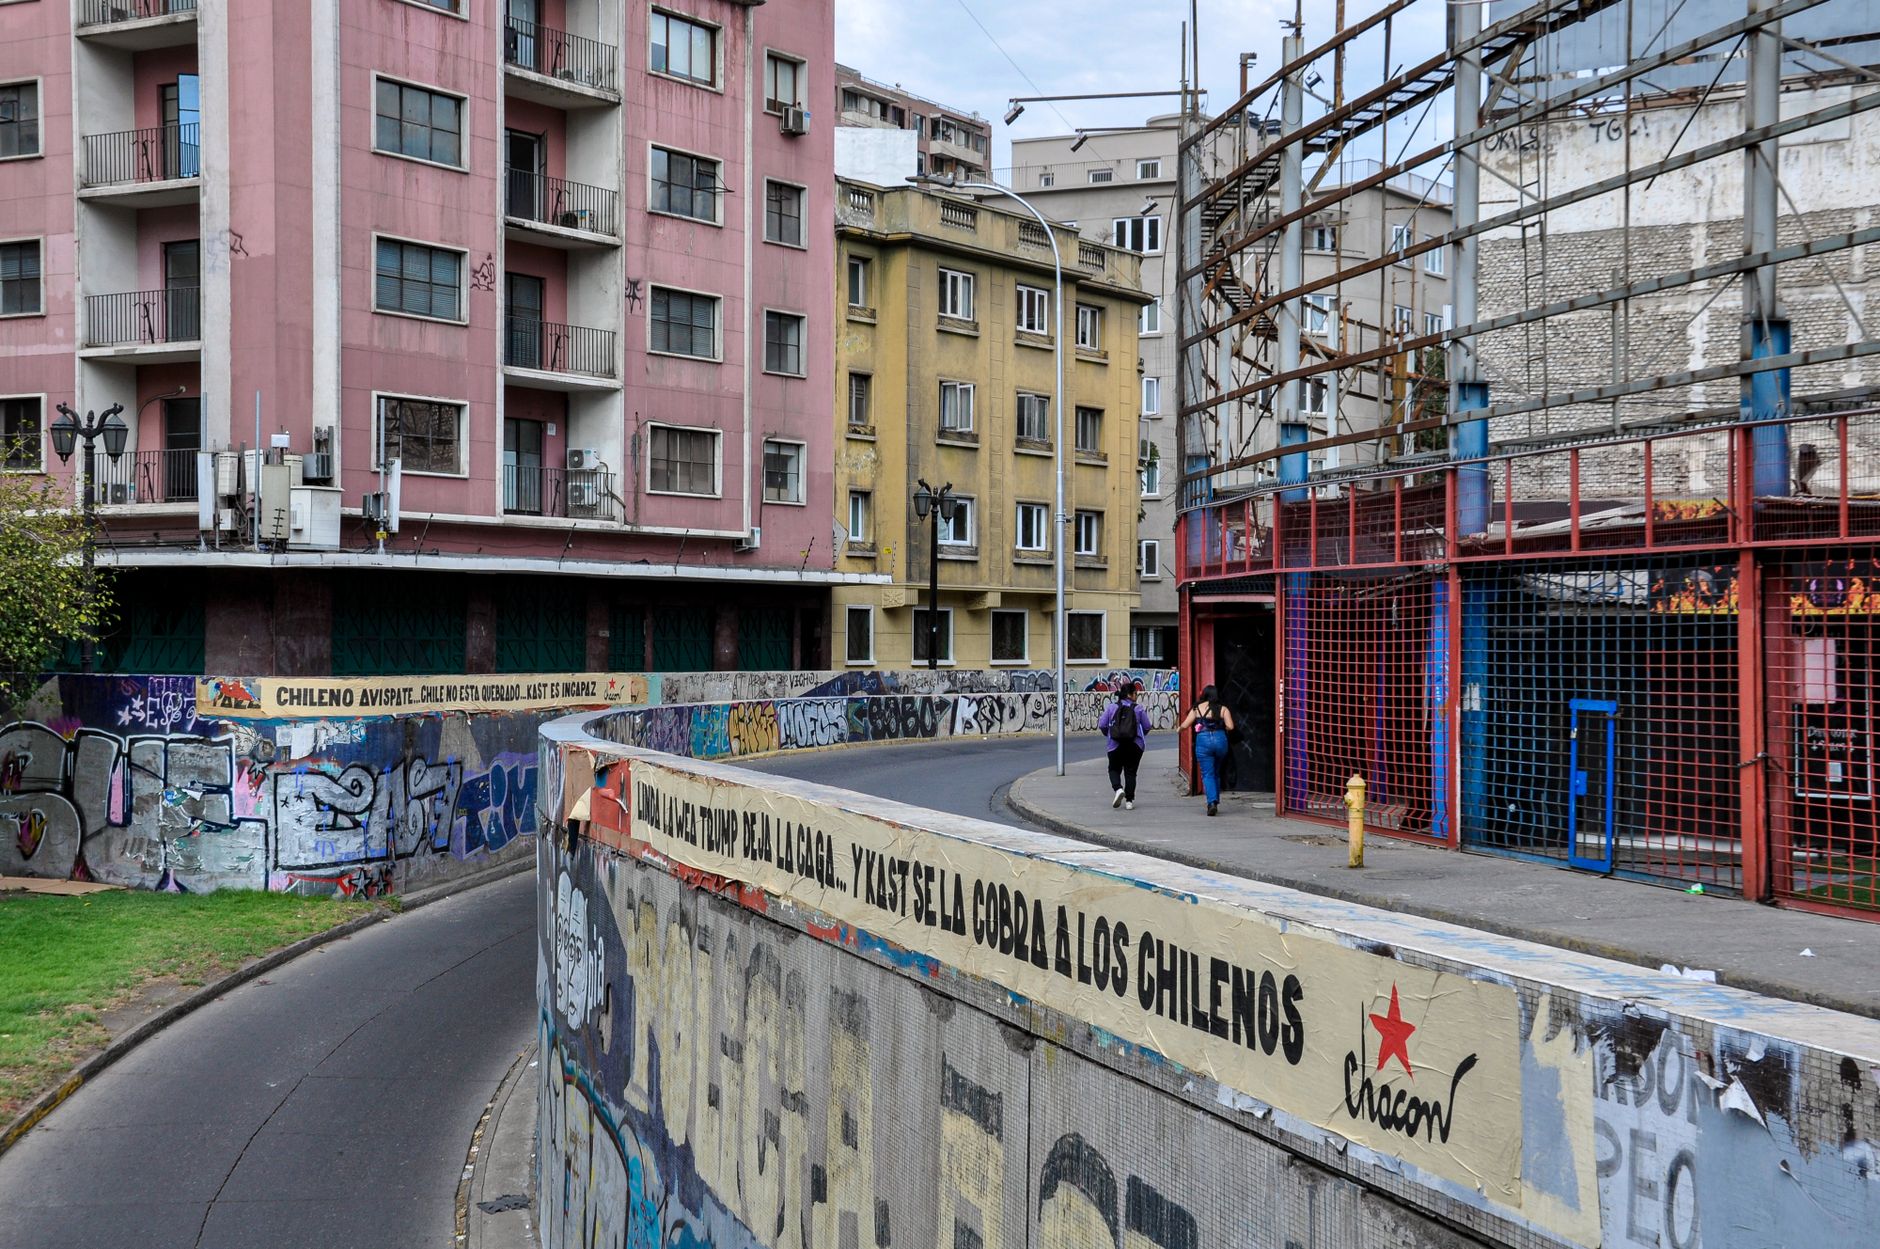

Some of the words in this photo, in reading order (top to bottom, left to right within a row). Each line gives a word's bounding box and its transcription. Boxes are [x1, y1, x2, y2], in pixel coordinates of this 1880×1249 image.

[276, 686, 354, 707] CHILENO
[446, 685, 458, 702] NO
[460, 684, 480, 702] ESTA
[550, 681, 560, 698] ES
[562, 681, 596, 698] INCAPAZ
[637, 781, 660, 830] LINDA
[663, 793, 673, 838] LA
[674, 797, 697, 846] WEA
[699, 805, 738, 858] TRUMP
[743, 810, 772, 863] DEJA
[776, 818, 793, 874] LA
[851, 842, 863, 898] Y
[865, 849, 910, 918] KAST
[913, 860, 937, 927] SE
[940, 869, 966, 937] LA
[973, 878, 1049, 970] COBRA
[1054, 905, 1072, 979] A
[1077, 911, 1130, 998] LOS
[1137, 931, 1305, 1066] CHILENOS
